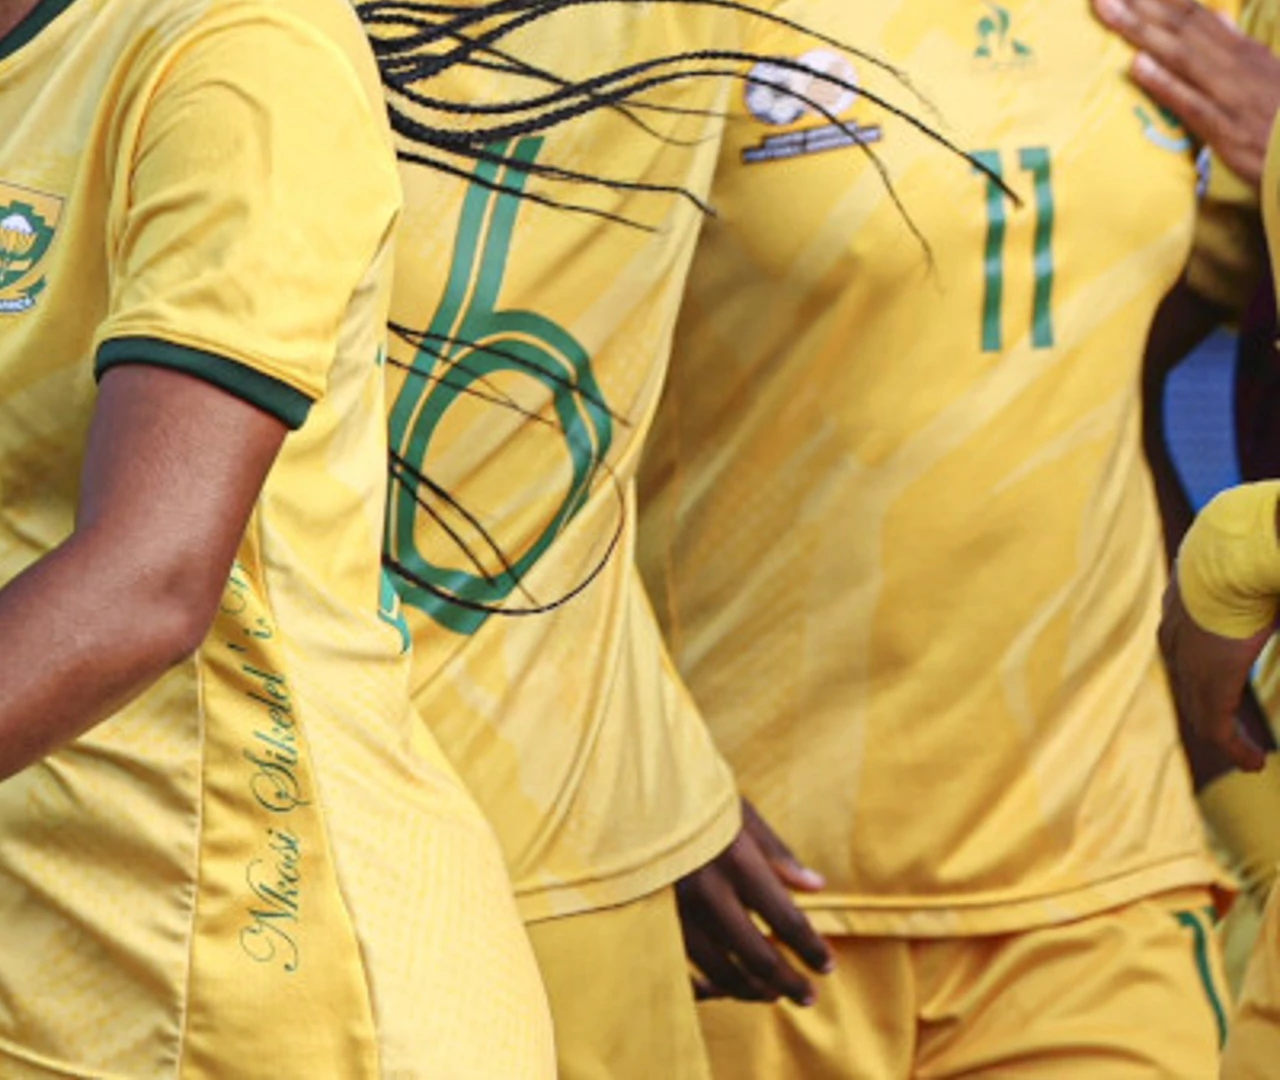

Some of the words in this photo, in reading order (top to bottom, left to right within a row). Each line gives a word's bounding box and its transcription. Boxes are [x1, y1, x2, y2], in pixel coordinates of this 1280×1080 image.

[970, 147, 1055, 351] 11
[382, 135, 614, 635] 6
[239, 827, 301, 972] Nkosi
